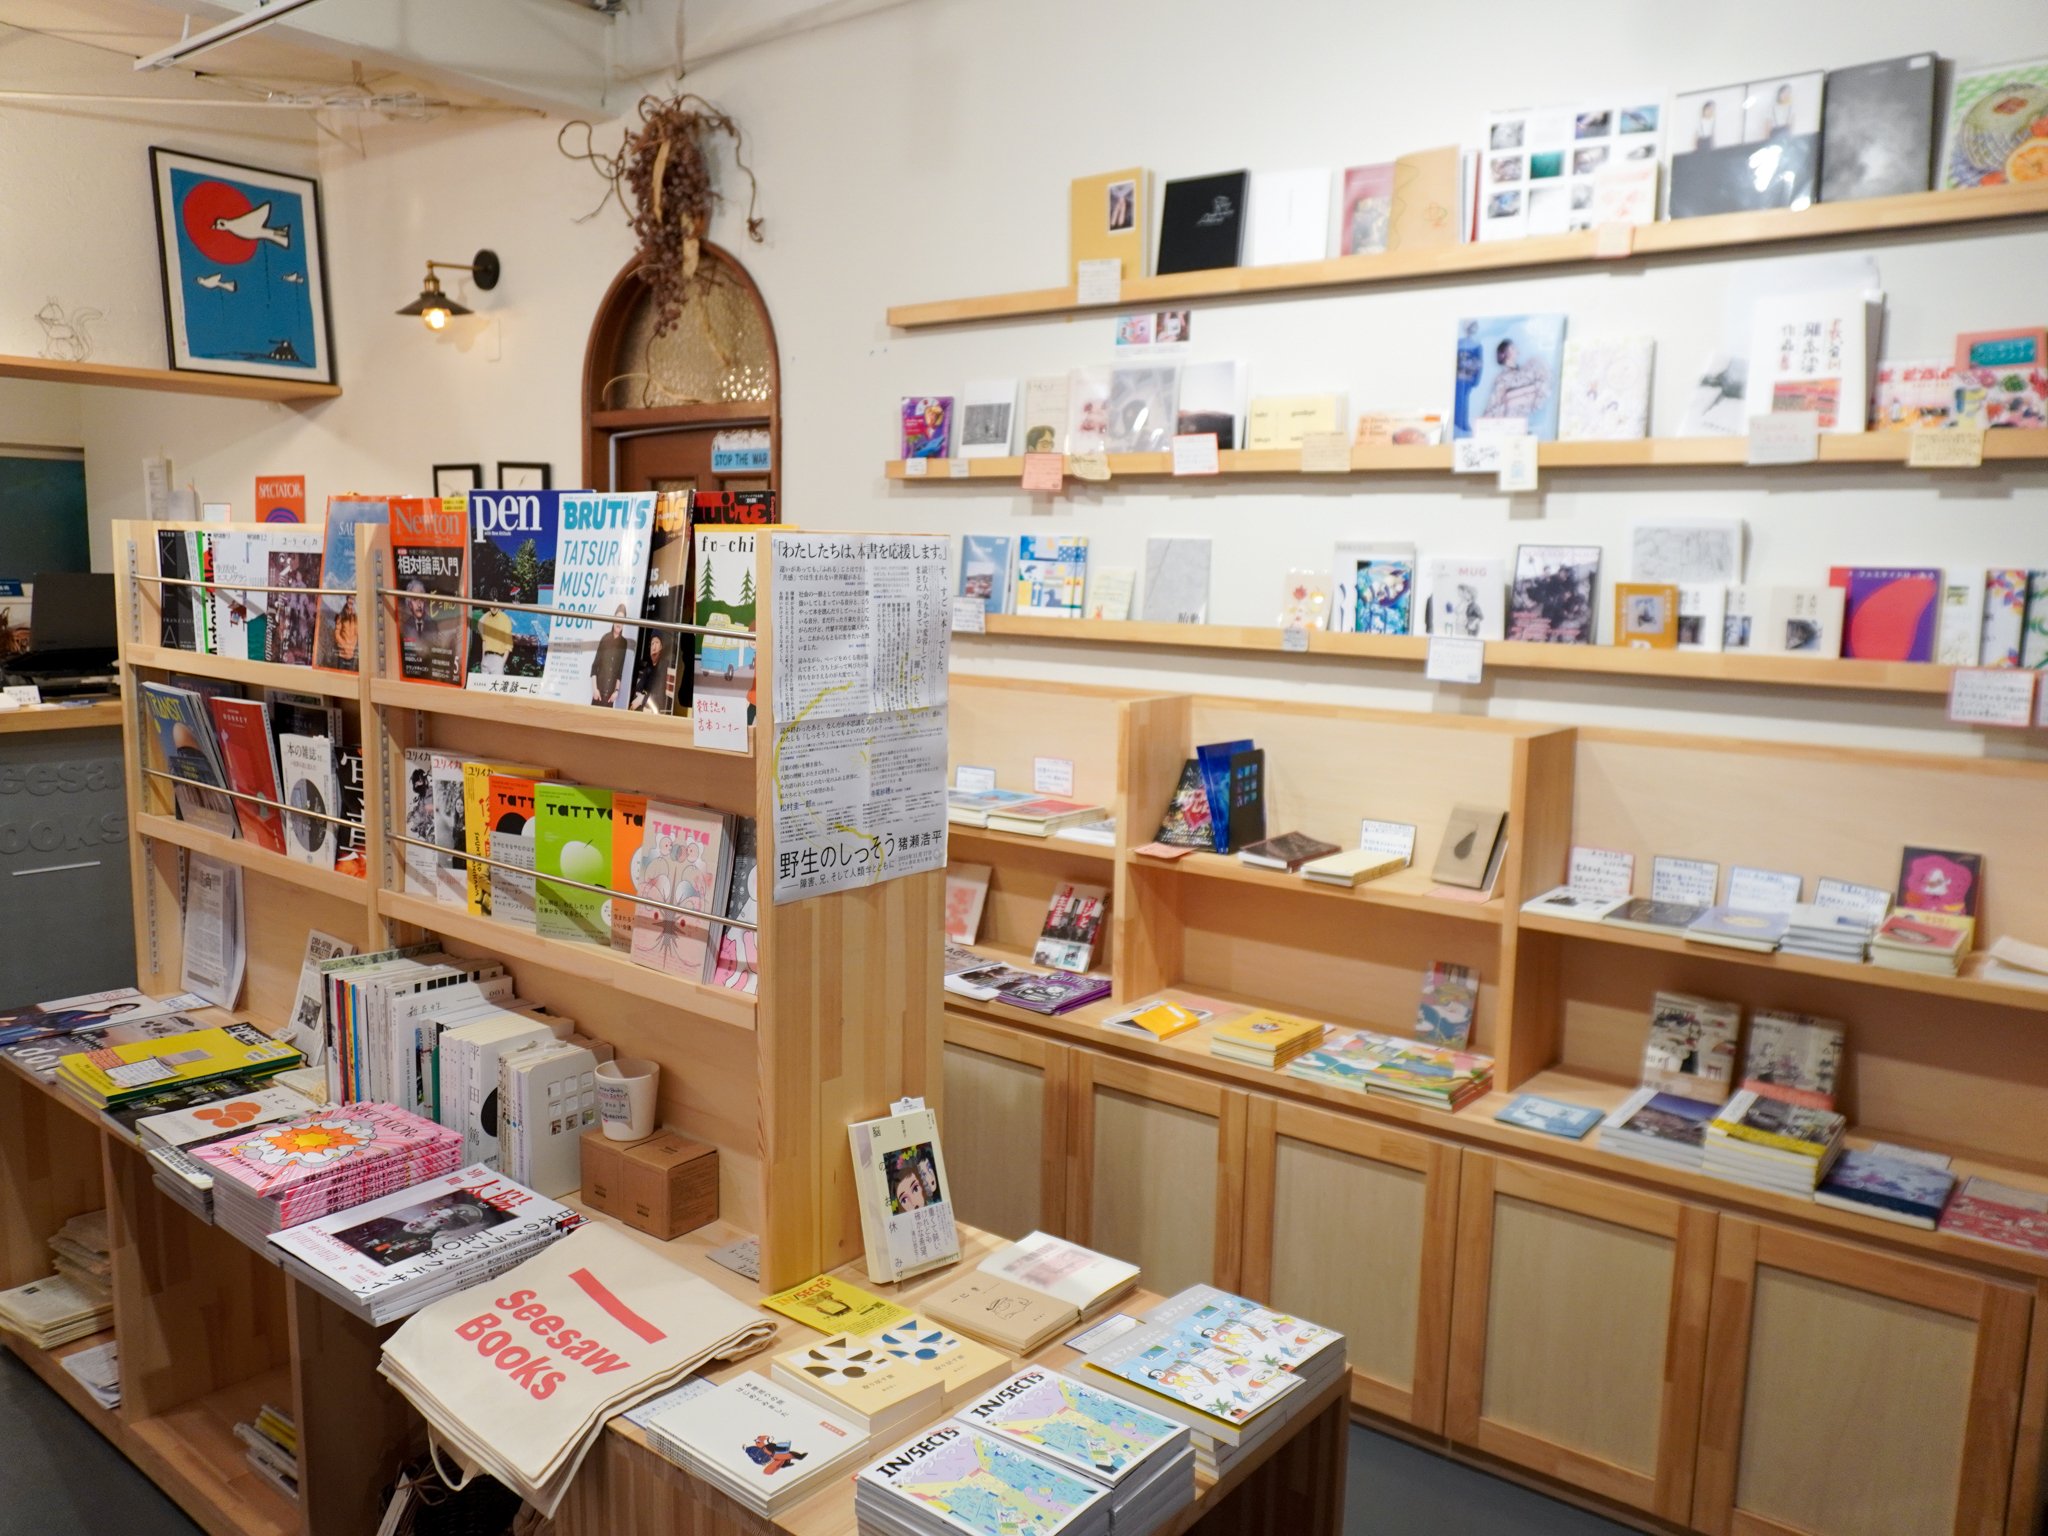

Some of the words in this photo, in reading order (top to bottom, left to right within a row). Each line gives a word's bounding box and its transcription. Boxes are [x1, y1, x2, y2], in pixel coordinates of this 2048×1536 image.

[714, 453, 733, 466] STOP
[735, 453, 748, 465] THE
[752, 452, 768, 465] WAR
[258, 482, 303, 499] SPECTATOR
[395, 506, 460, 536] Newton
[472, 494, 542, 543] pen
[562, 498, 651, 531] BRUTUS
[778, 541, 947, 560] 「わたしたちは、本書を応援します。」
[397, 556, 459, 577] 相対論再入門
[1458, 566, 1487, 578] MUG
[559, 572, 608, 598] MUSIC
[453, 656, 460, 674] 5
[406, 750, 431, 762] ユリイカ
[433, 757, 462, 769] ユリイカ
[780, 832, 895, 879] 野生のしっそう
[898, 830, 943, 852] 猪瀬浩平
[495, 1288, 631, 1376] seesaw
[969, 1372, 1043, 1419] IN/SECTS
[876, 1426, 960, 1478] IN/SECTS
